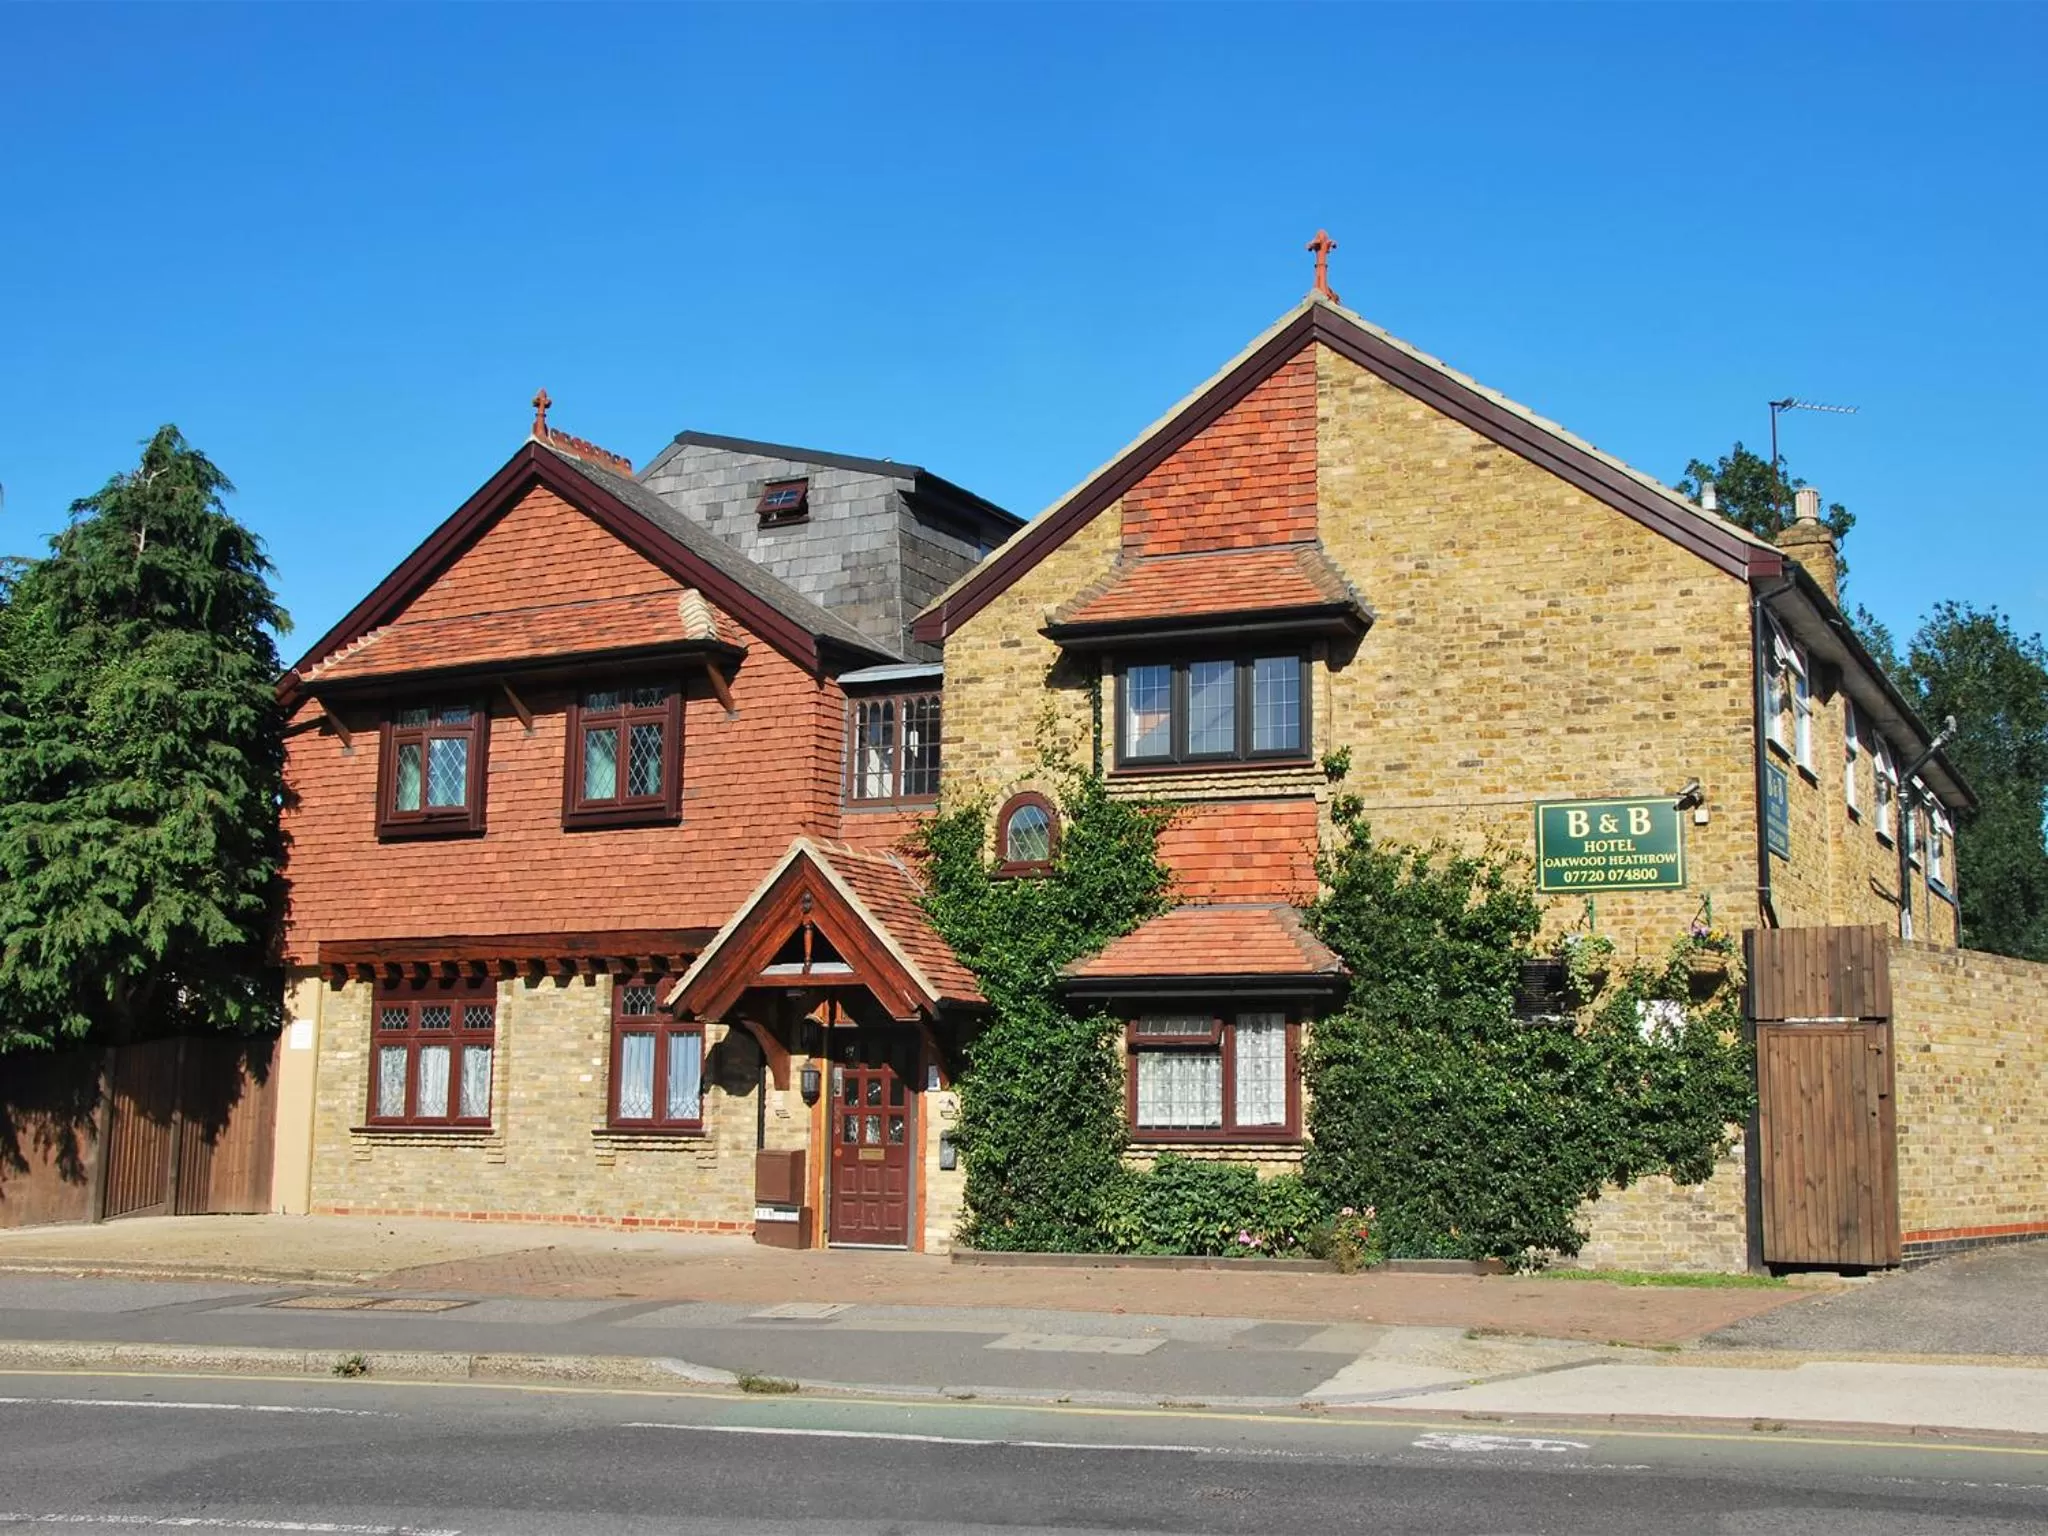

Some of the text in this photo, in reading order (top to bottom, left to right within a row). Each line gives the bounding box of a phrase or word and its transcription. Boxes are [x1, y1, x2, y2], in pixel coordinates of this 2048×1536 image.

[1566, 807, 1651, 838] B & B
[1584, 839, 1636, 853] HOTEL
[1545, 853, 1677, 868] OAKWOOD HEATHROW
[1563, 868, 1658, 883] 07720 074800
